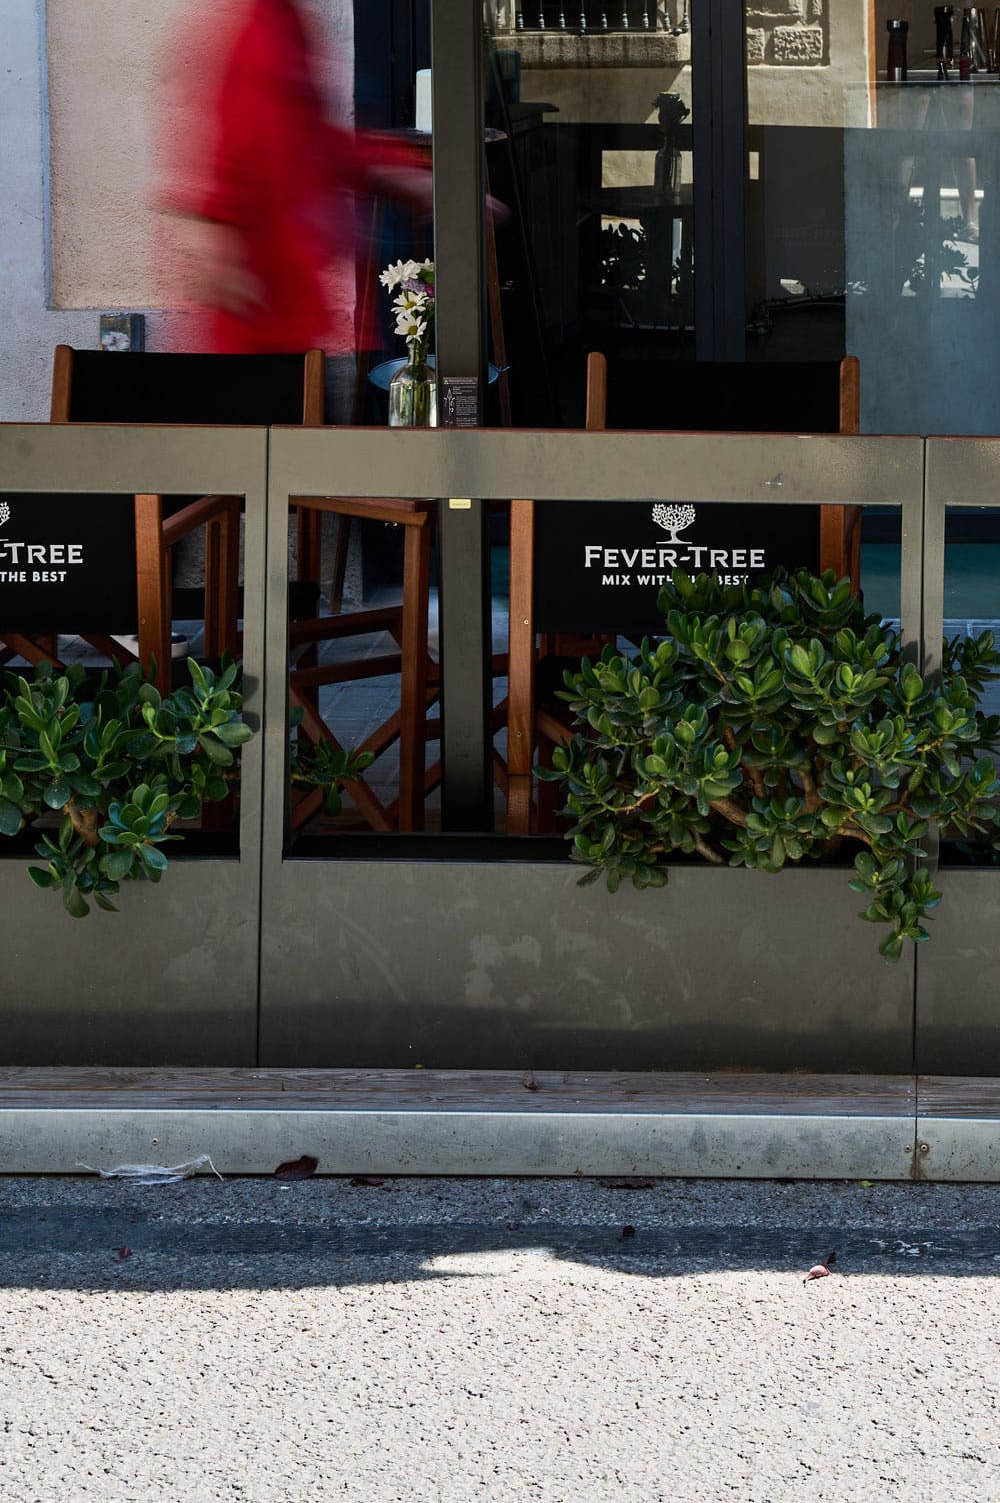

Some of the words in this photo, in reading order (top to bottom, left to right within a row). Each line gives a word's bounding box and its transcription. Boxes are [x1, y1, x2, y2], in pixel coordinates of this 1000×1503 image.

[584, 545, 766, 568] FEVER-TREE
[0, 571, 27, 583] THE
[32, 571, 67, 583] BEST
[602, 574, 631, 586] MIX
